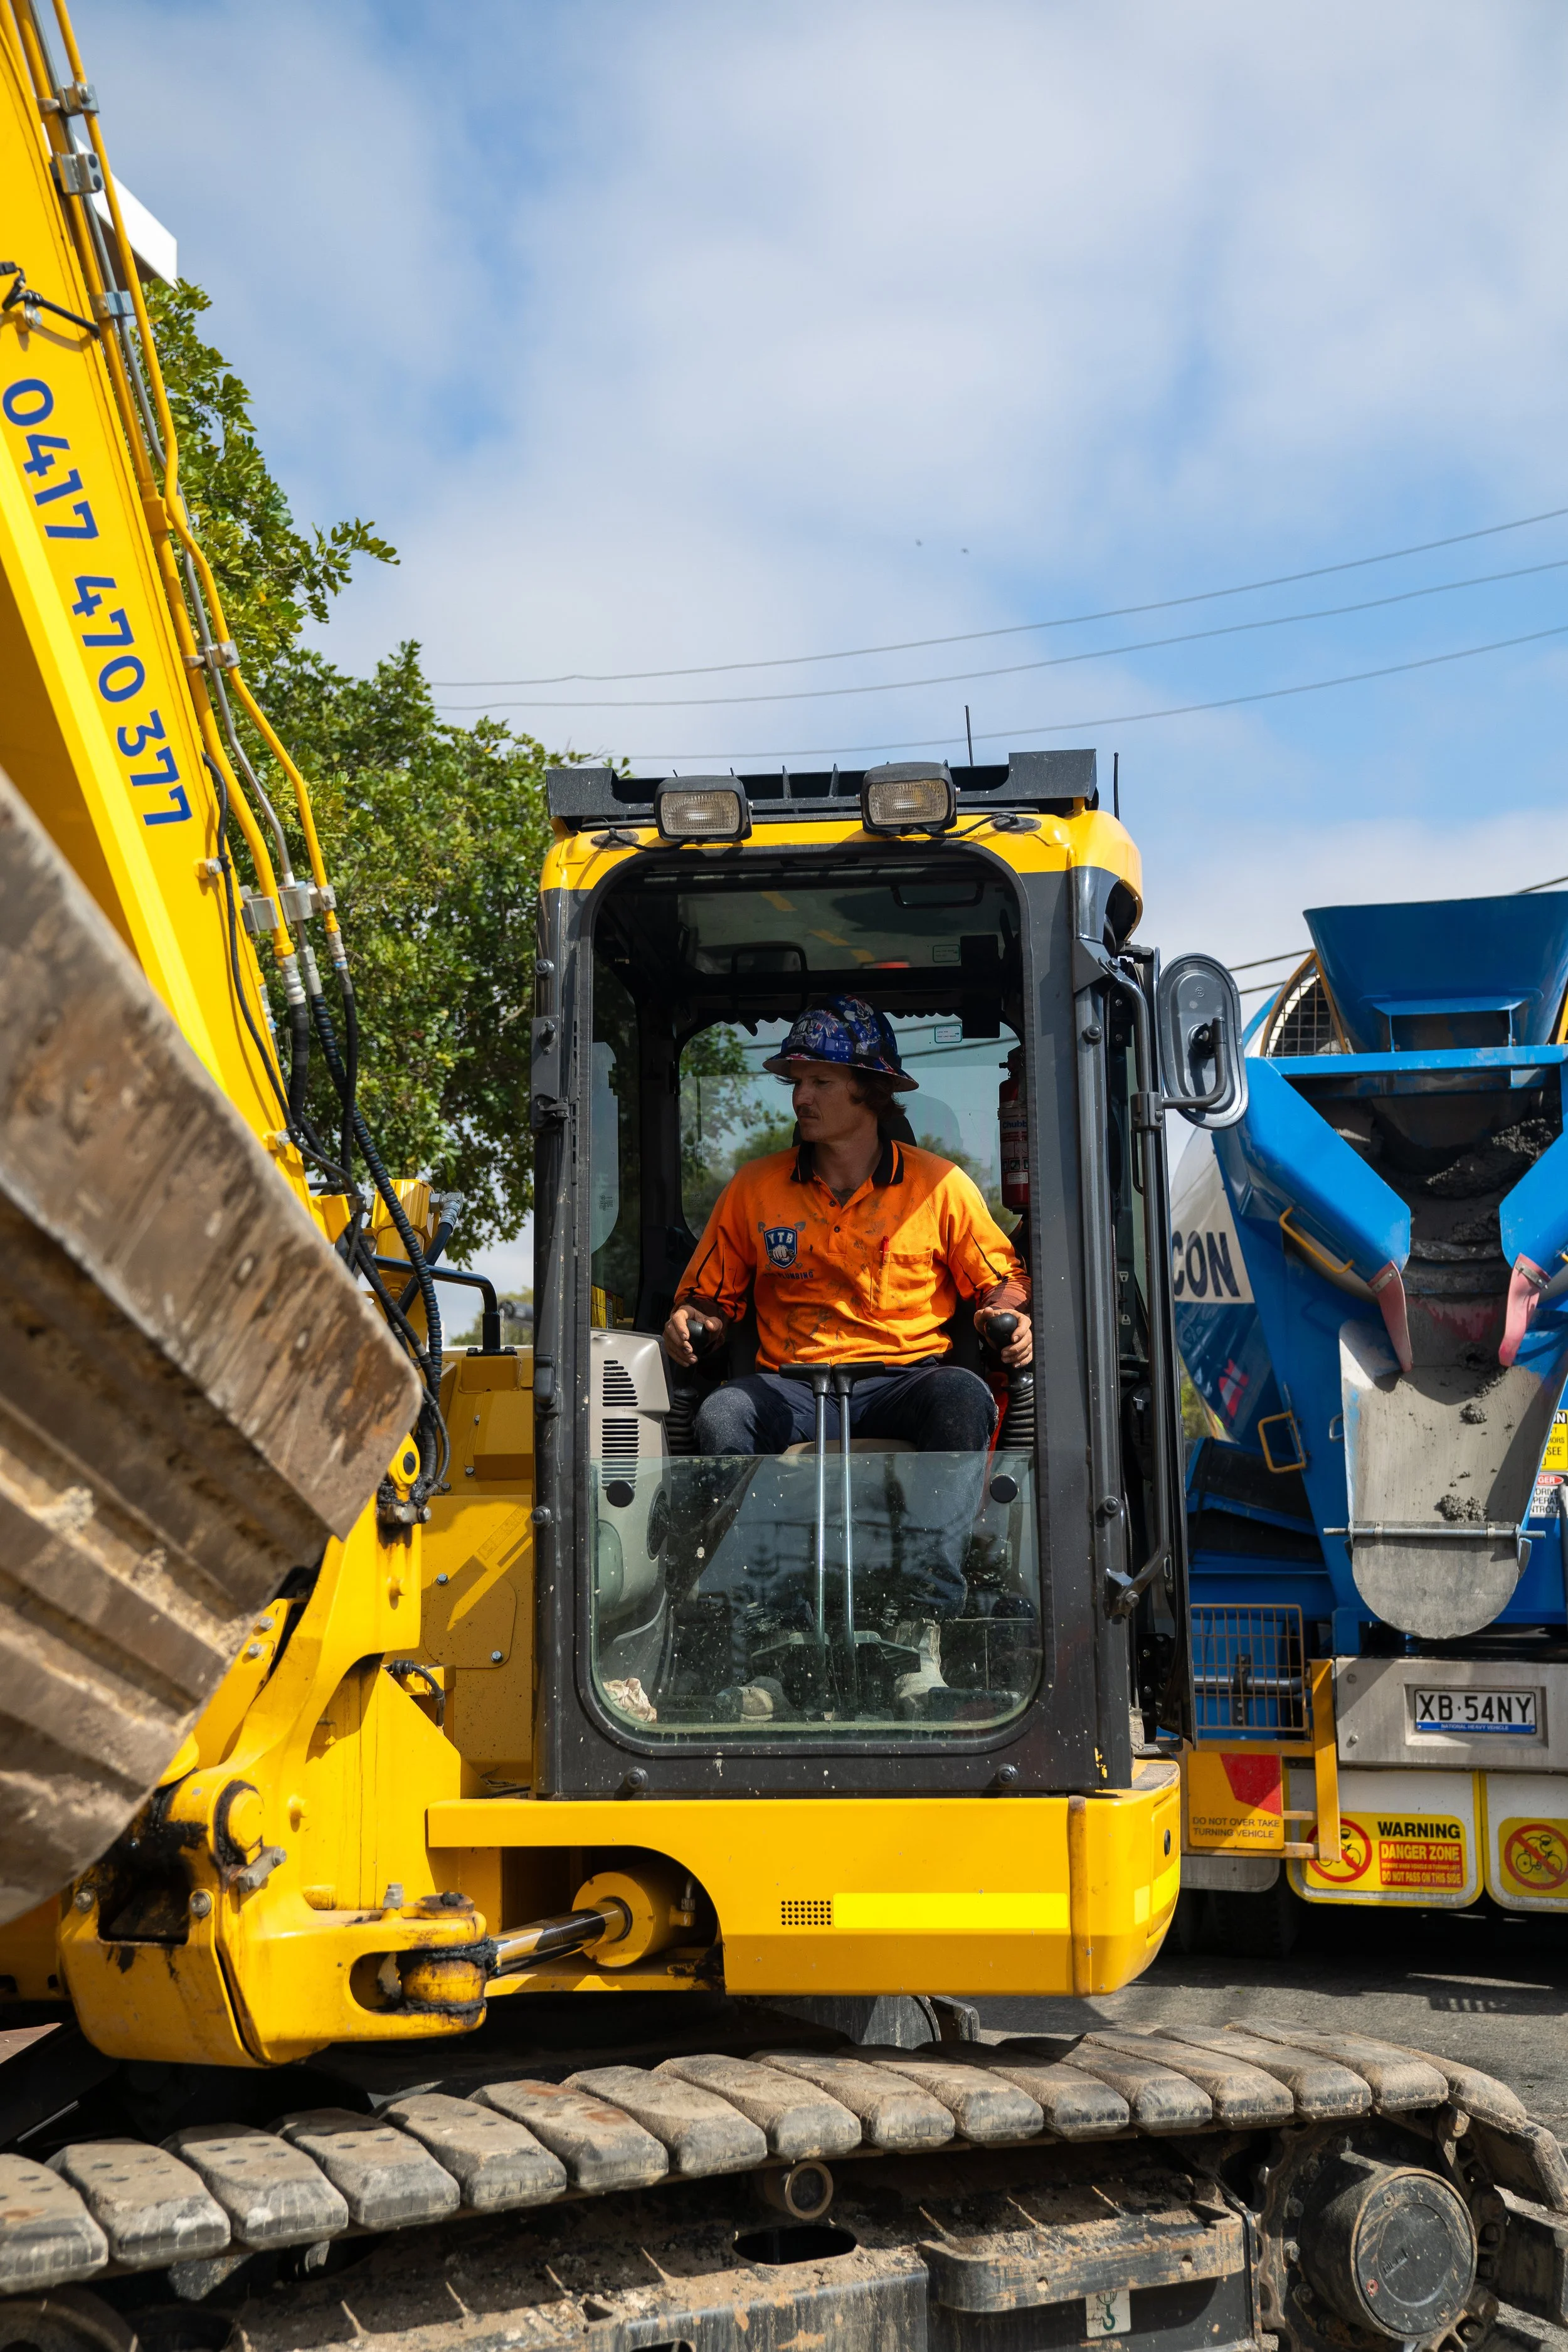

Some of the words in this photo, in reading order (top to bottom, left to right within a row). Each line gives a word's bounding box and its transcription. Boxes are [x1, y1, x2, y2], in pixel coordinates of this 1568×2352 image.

[3, 378, 100, 539] 0417
[72, 575, 146, 703] 470
[117, 709, 193, 826] 377
[767, 1232, 793, 1244] YTB
[1172, 1230, 1241, 1298] CON
[1547, 1446, 1562, 1455] SEE
[1192, 1816, 1206, 1825] DO
[1209, 1817, 1227, 1825] NOT
[1229, 1818, 1255, 1826] OVER
[1258, 1819, 1280, 1827] TAKE
[1193, 1828, 1234, 1836] TURNING
[1236, 1830, 1274, 1838] VEHICLE
[1377, 1821, 1461, 1839] WARNING
[1380, 1843, 1428, 1860] DANGER
[1429, 1845, 1460, 1862] ZONE
[1382, 1870, 1391, 1882] DO
[1392, 1871, 1404, 1882] NOT
[1406, 1872, 1421, 1883] PASS
[1421, 1872, 1431, 1883] ON
[1431, 1872, 1446, 1883] THIS
[1446, 1873, 1461, 1884] SIDE
